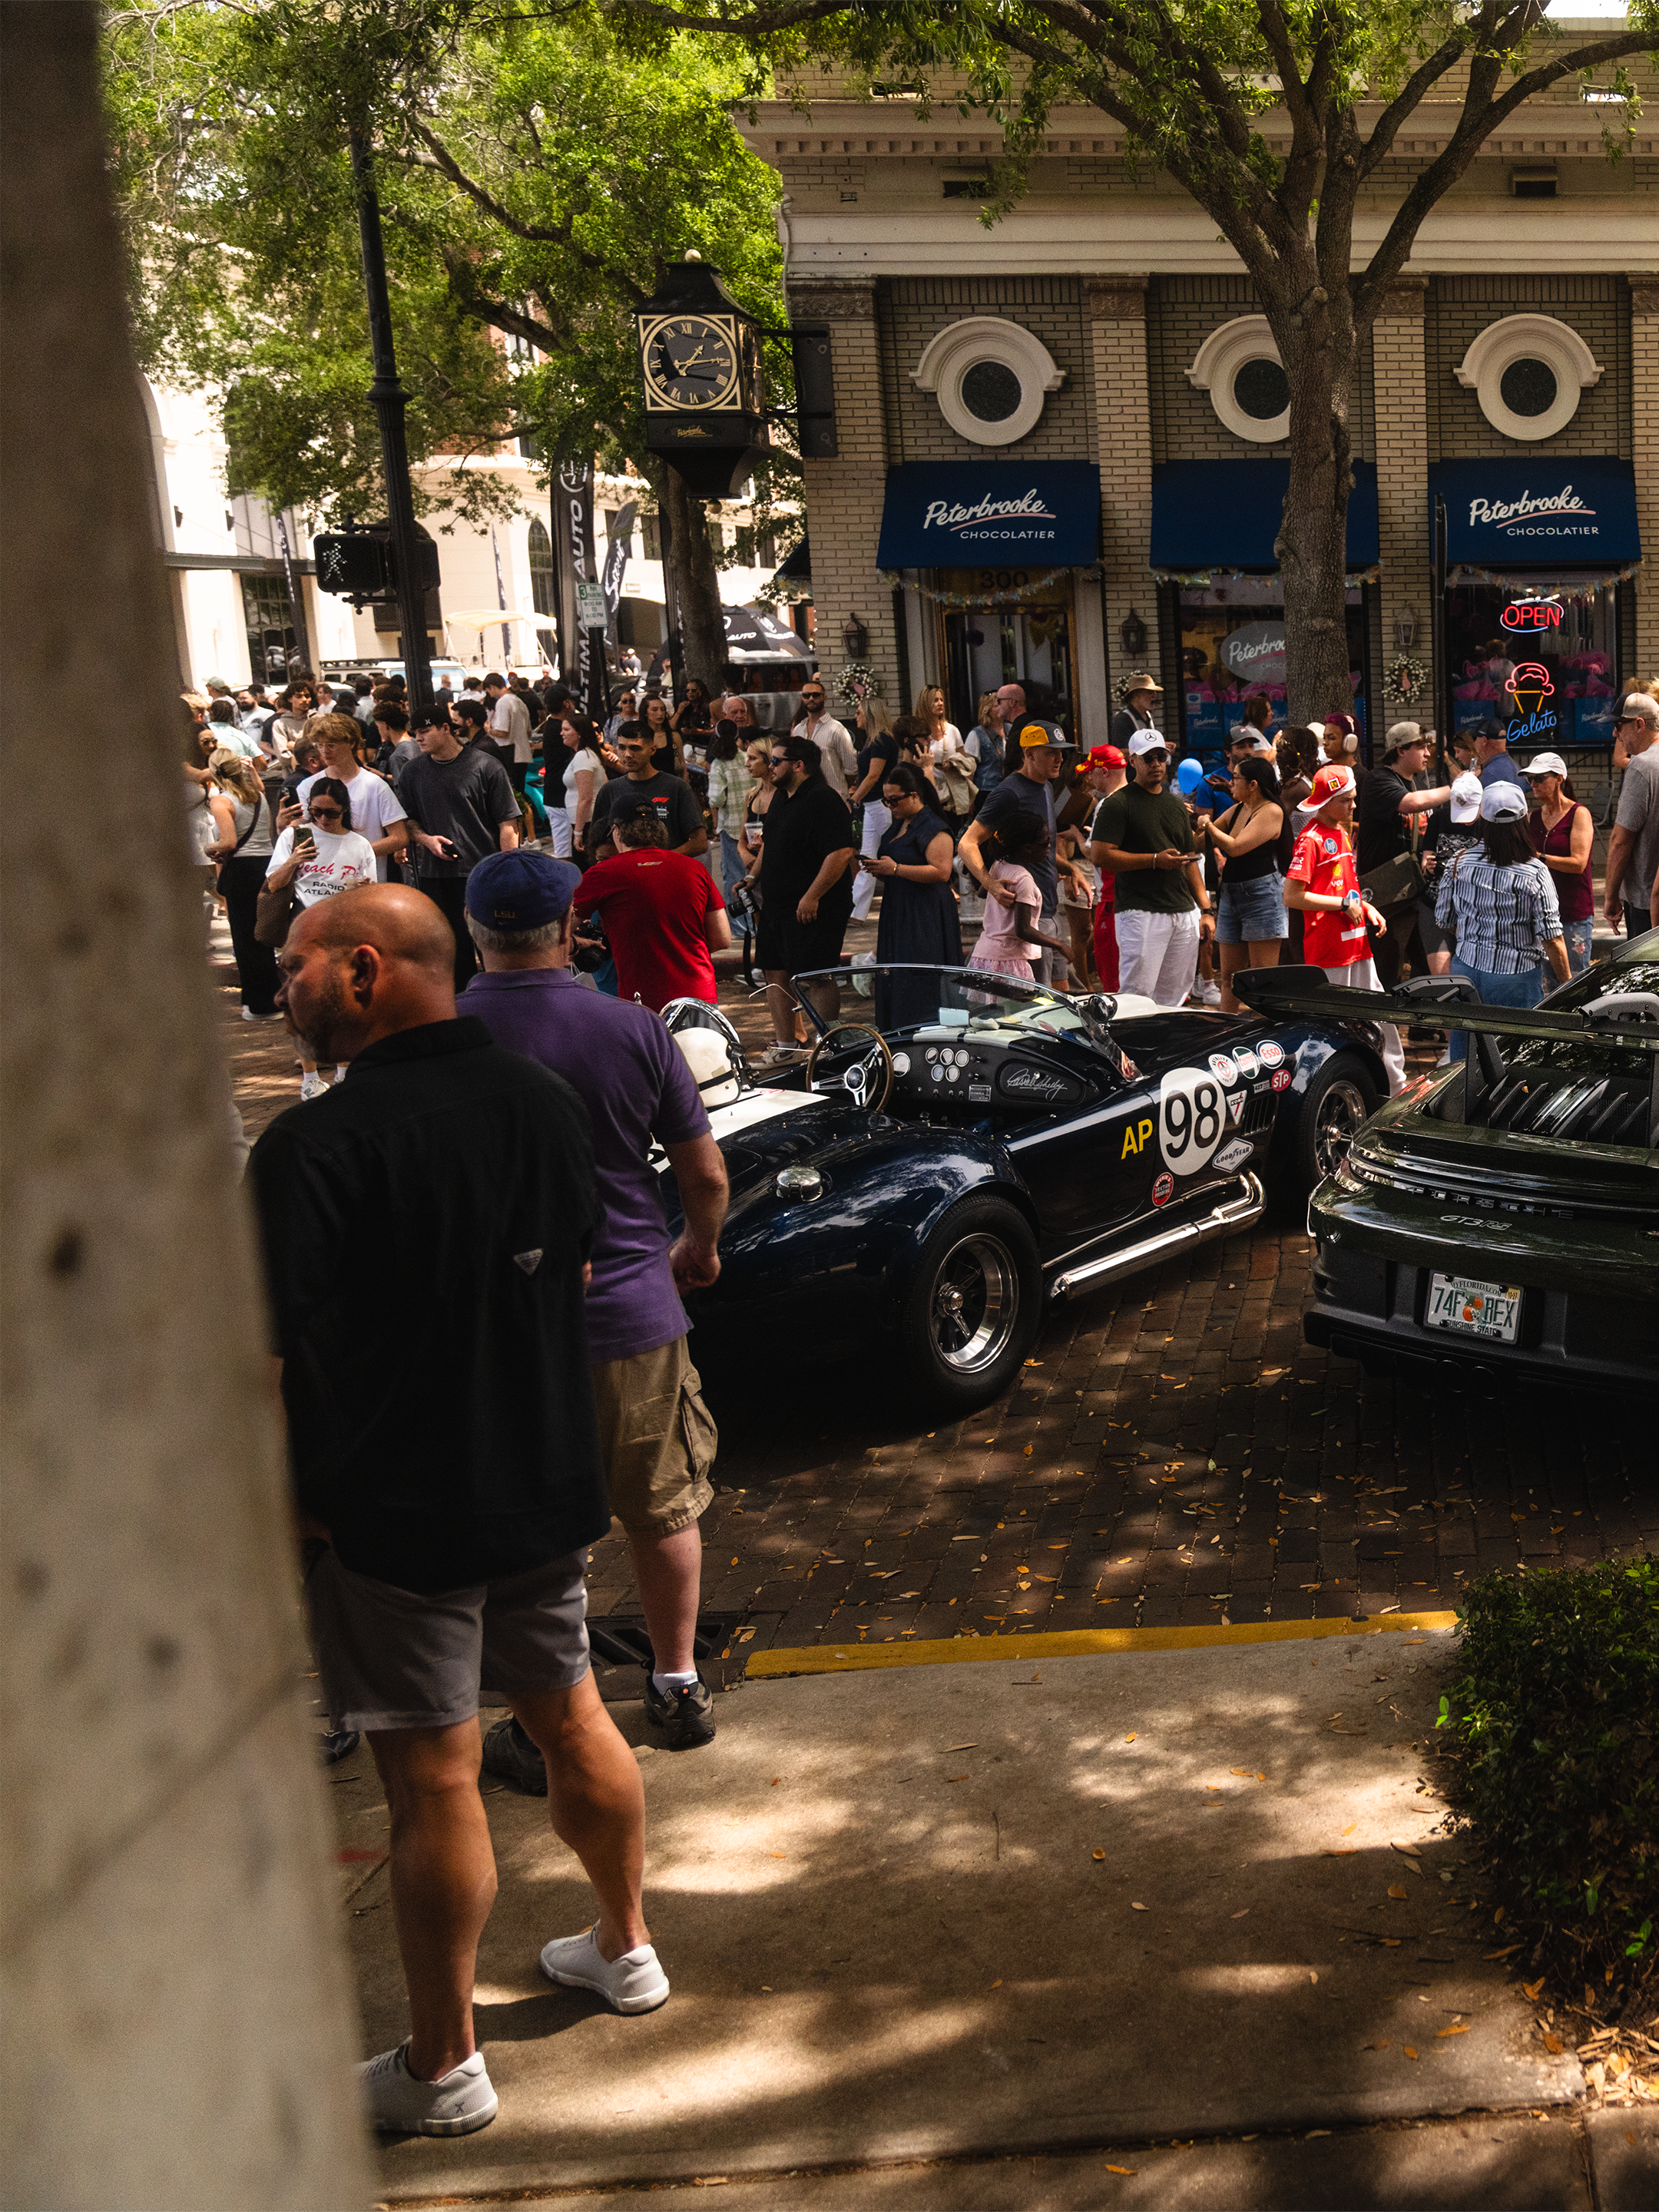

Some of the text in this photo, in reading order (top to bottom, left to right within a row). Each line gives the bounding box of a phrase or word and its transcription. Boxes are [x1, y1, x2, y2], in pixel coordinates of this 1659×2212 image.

[664, 326, 676, 340] XI
[680, 323, 692, 334] XII
[714, 340, 725, 350] II
[923, 488, 1046, 529] Peterbrooke
[1469, 485, 1584, 527] Peterbrooke
[960, 531, 1055, 539] CHOCOLATIER
[1507, 526, 1599, 535] CHOCOLATIER
[570, 499, 586, 581] AUTO
[981, 571, 1028, 589] 300
[580, 587, 586, 598] 3
[1503, 605, 1561, 626] OPEN
[727, 632, 757, 641] AUTO
[1506, 709, 1558, 742] Gelato
[313, 881, 345, 892] RADIO
[495, 909, 515, 919] LSU
[1273, 1071, 1289, 1088] STP
[1164, 1081, 1220, 1158] 98
[1121, 1118, 1153, 1160] AP
[1406, 1186, 1574, 1220] PORSCHE
[1434, 1286, 1465, 1317] 74F
[1477, 1323, 1497, 1336] STAT
